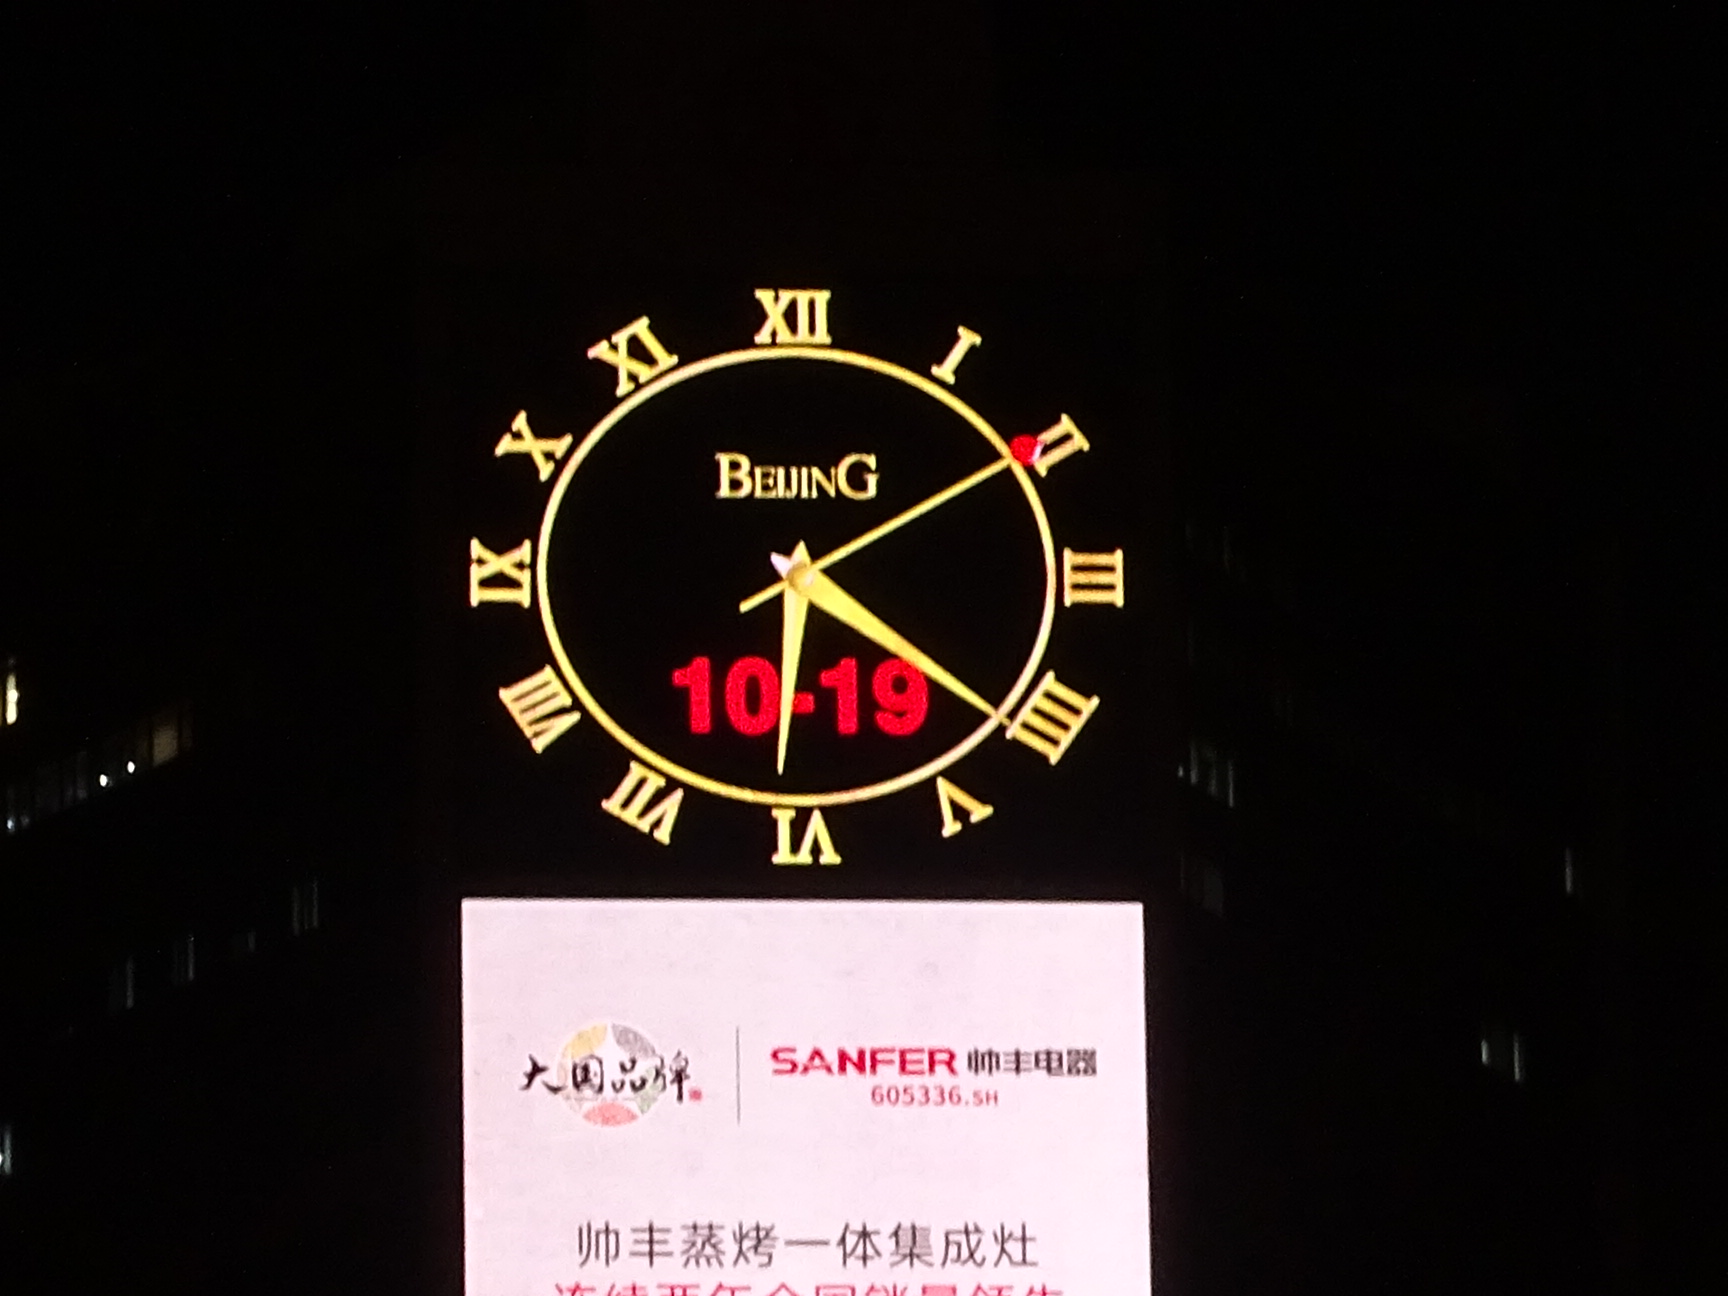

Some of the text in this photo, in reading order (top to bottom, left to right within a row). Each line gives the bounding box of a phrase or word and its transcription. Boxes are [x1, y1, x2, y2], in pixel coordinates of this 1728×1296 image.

[754, 289, 832, 344] XII
[588, 316, 679, 398] XI
[930, 325, 981, 385] I
[495, 409, 573, 482] X
[1029, 413, 1090, 477] II
[470, 537, 532, 608] IX
[1063, 548, 1125, 608] III
[499, 665, 581, 754] VIII
[672, 656, 930, 737] 10-19
[1006, 670, 1100, 766] IIII
[601, 760, 683, 844] VII
[935, 775, 993, 837] V
[771, 808, 842, 865] VI
[520, 1049, 690, 1104] 大国品牌
[770, 1047, 1098, 1078] SANFER 帅丰电器
[870, 1086, 1000, 1108] 605336.SH
[576, 1220, 1039, 1269] 帅丰蒸烤一体集成灶
